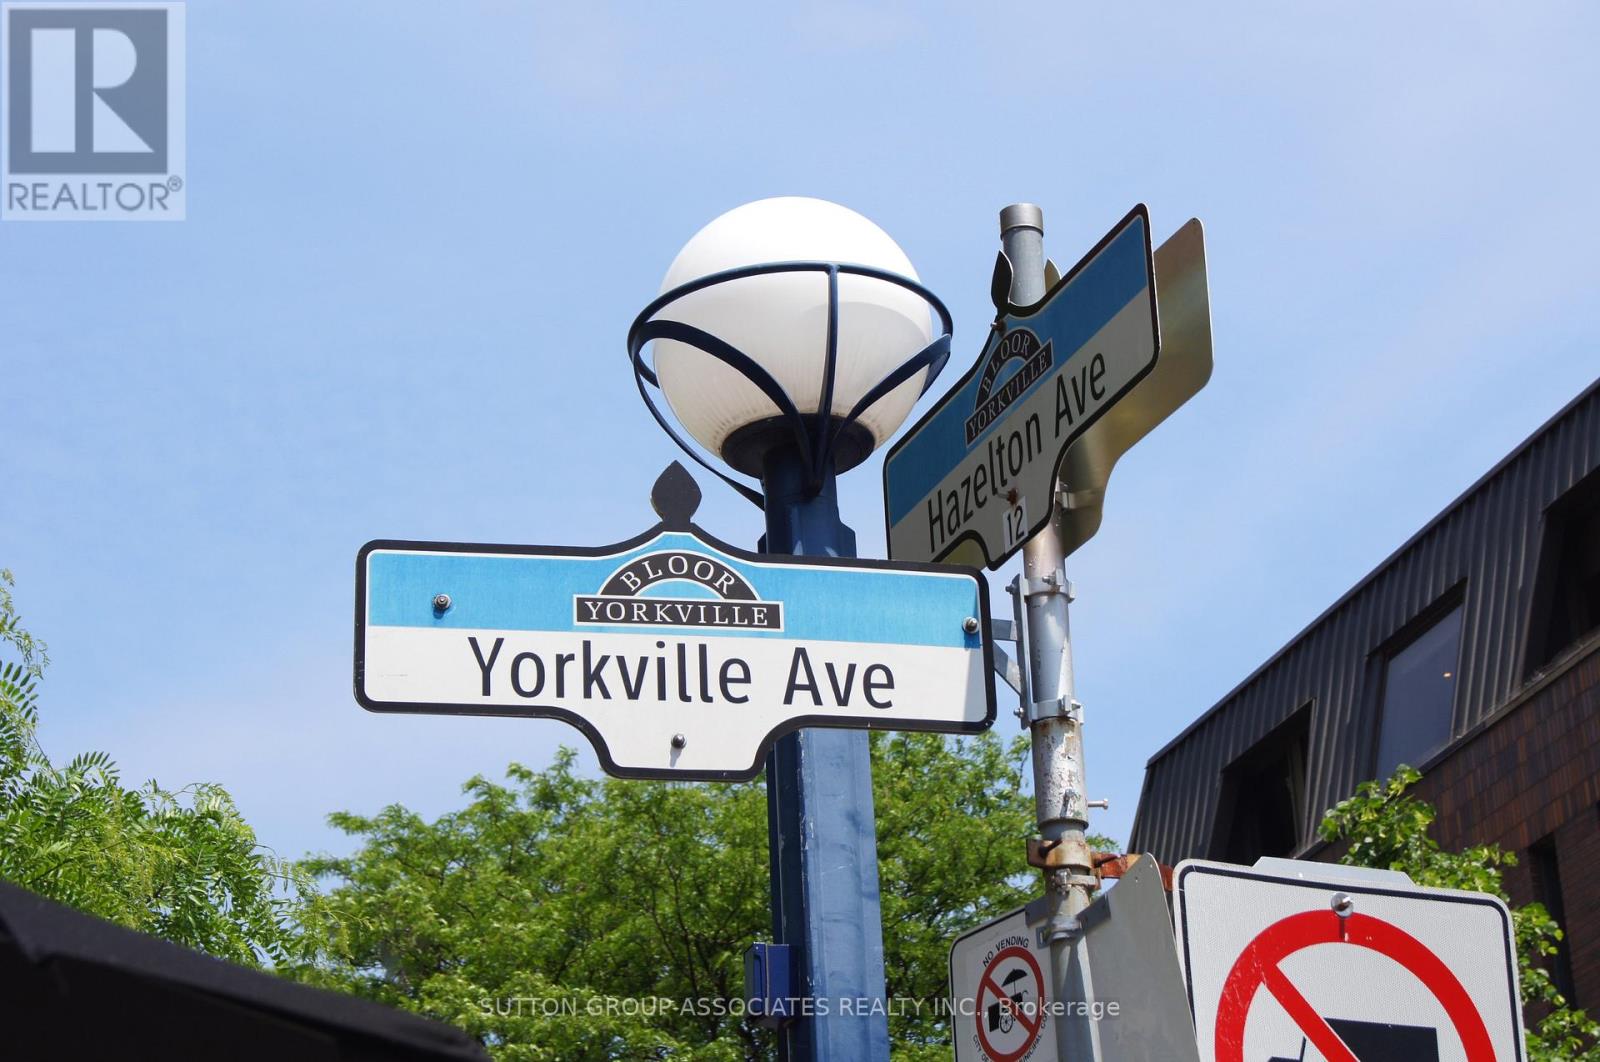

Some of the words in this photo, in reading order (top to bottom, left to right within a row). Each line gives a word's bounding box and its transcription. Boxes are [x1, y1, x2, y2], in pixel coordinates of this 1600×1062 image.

[982, 333, 1031, 393] BLOOR
[969, 351, 1047, 437] YORKVILLE
[928, 412, 1042, 553] Hazelton
[1054, 353, 1106, 438] Ave
[1007, 505, 1024, 546] 12
[619, 555, 735, 595] BLOOR
[584, 601, 768, 626] YORKVILLE
[468, 636, 751, 704] Yorkville
[783, 646, 895, 709] Ave
[982, 951, 994, 967] NO
[995, 935, 1029, 952] VENDING
